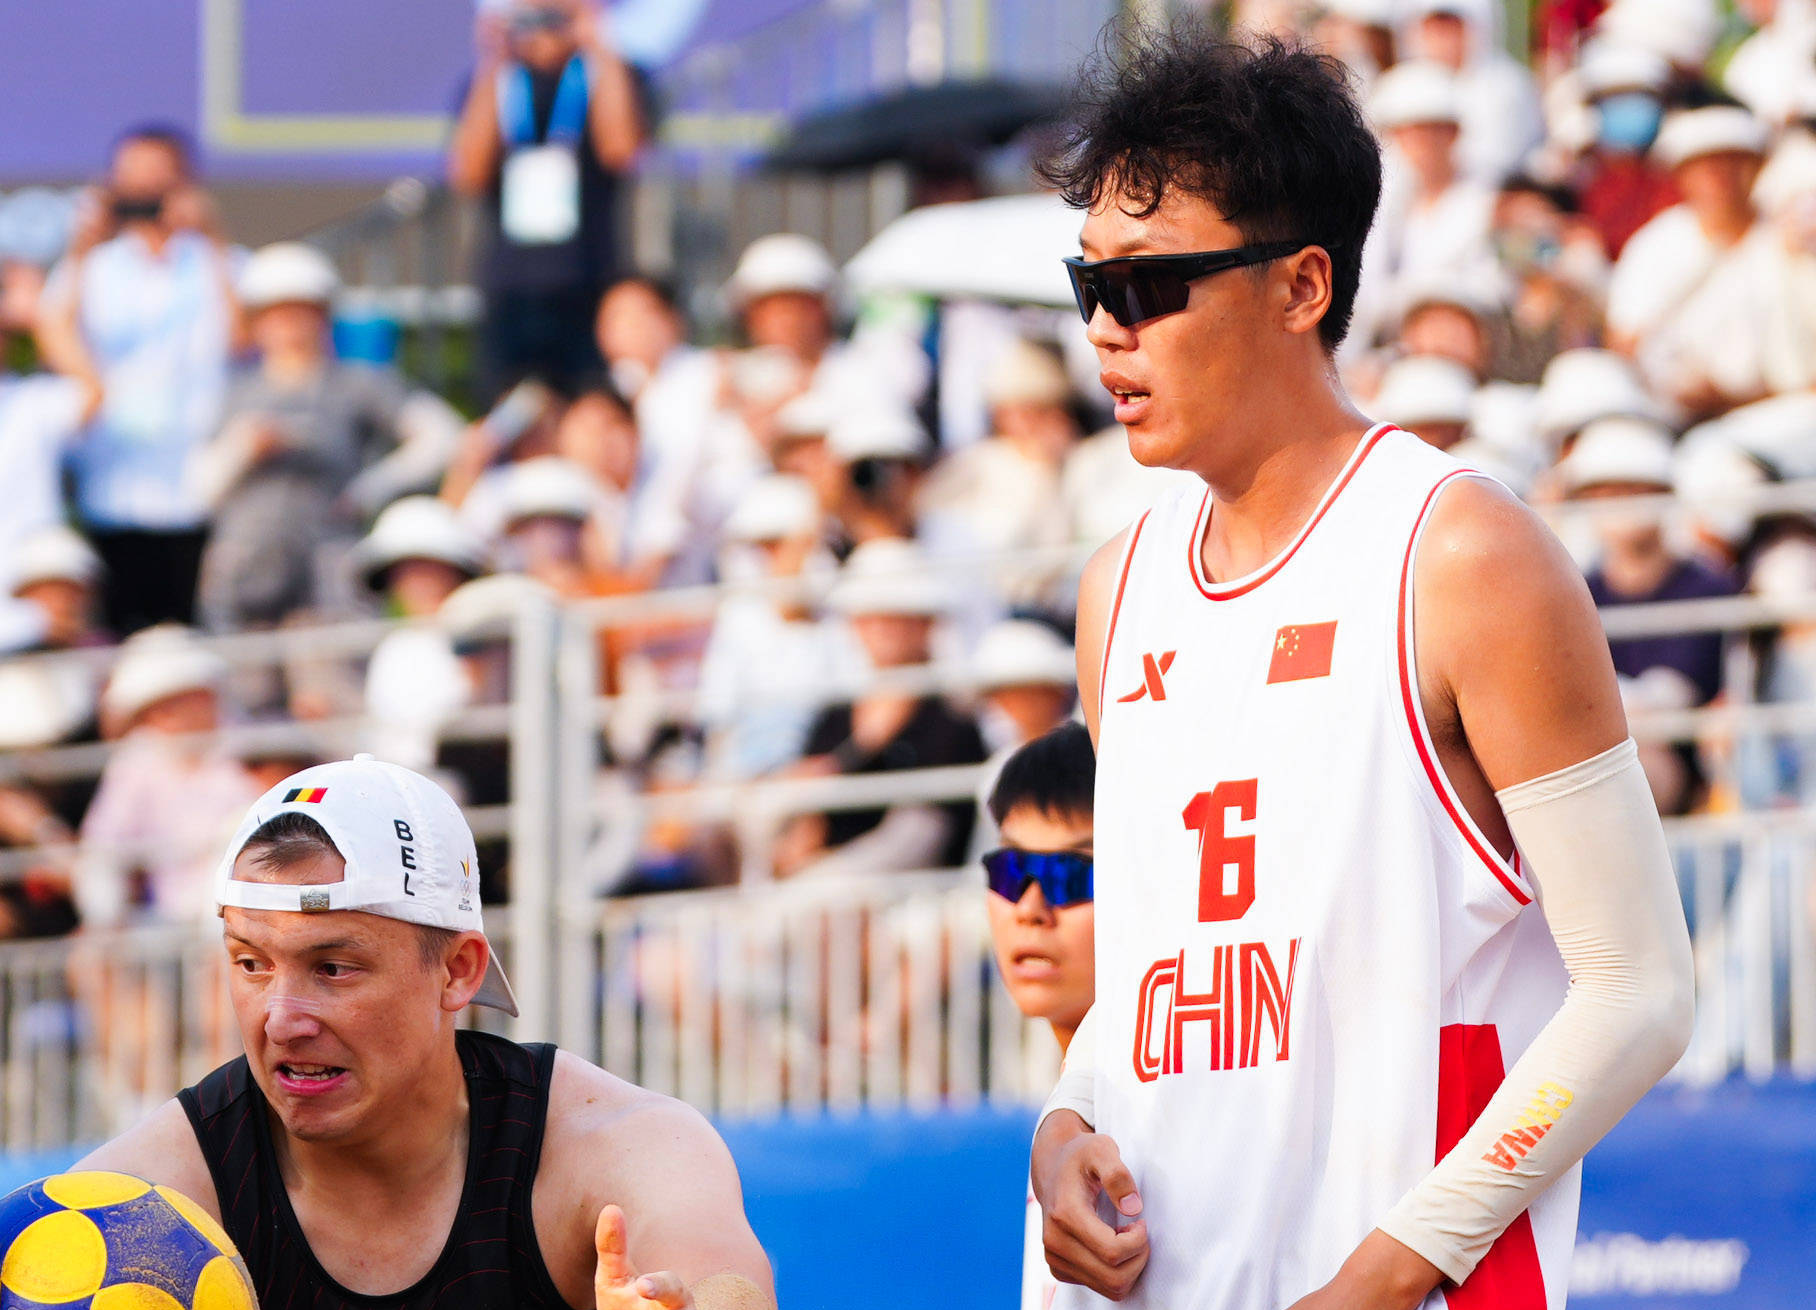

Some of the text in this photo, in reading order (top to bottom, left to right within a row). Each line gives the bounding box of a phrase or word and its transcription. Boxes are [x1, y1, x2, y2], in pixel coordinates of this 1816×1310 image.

[393, 818, 416, 897] BEL
[1181, 777, 1259, 923] 16
[1132, 936, 1302, 1083] CHN
[1481, 1081, 1574, 1172] CHINA
